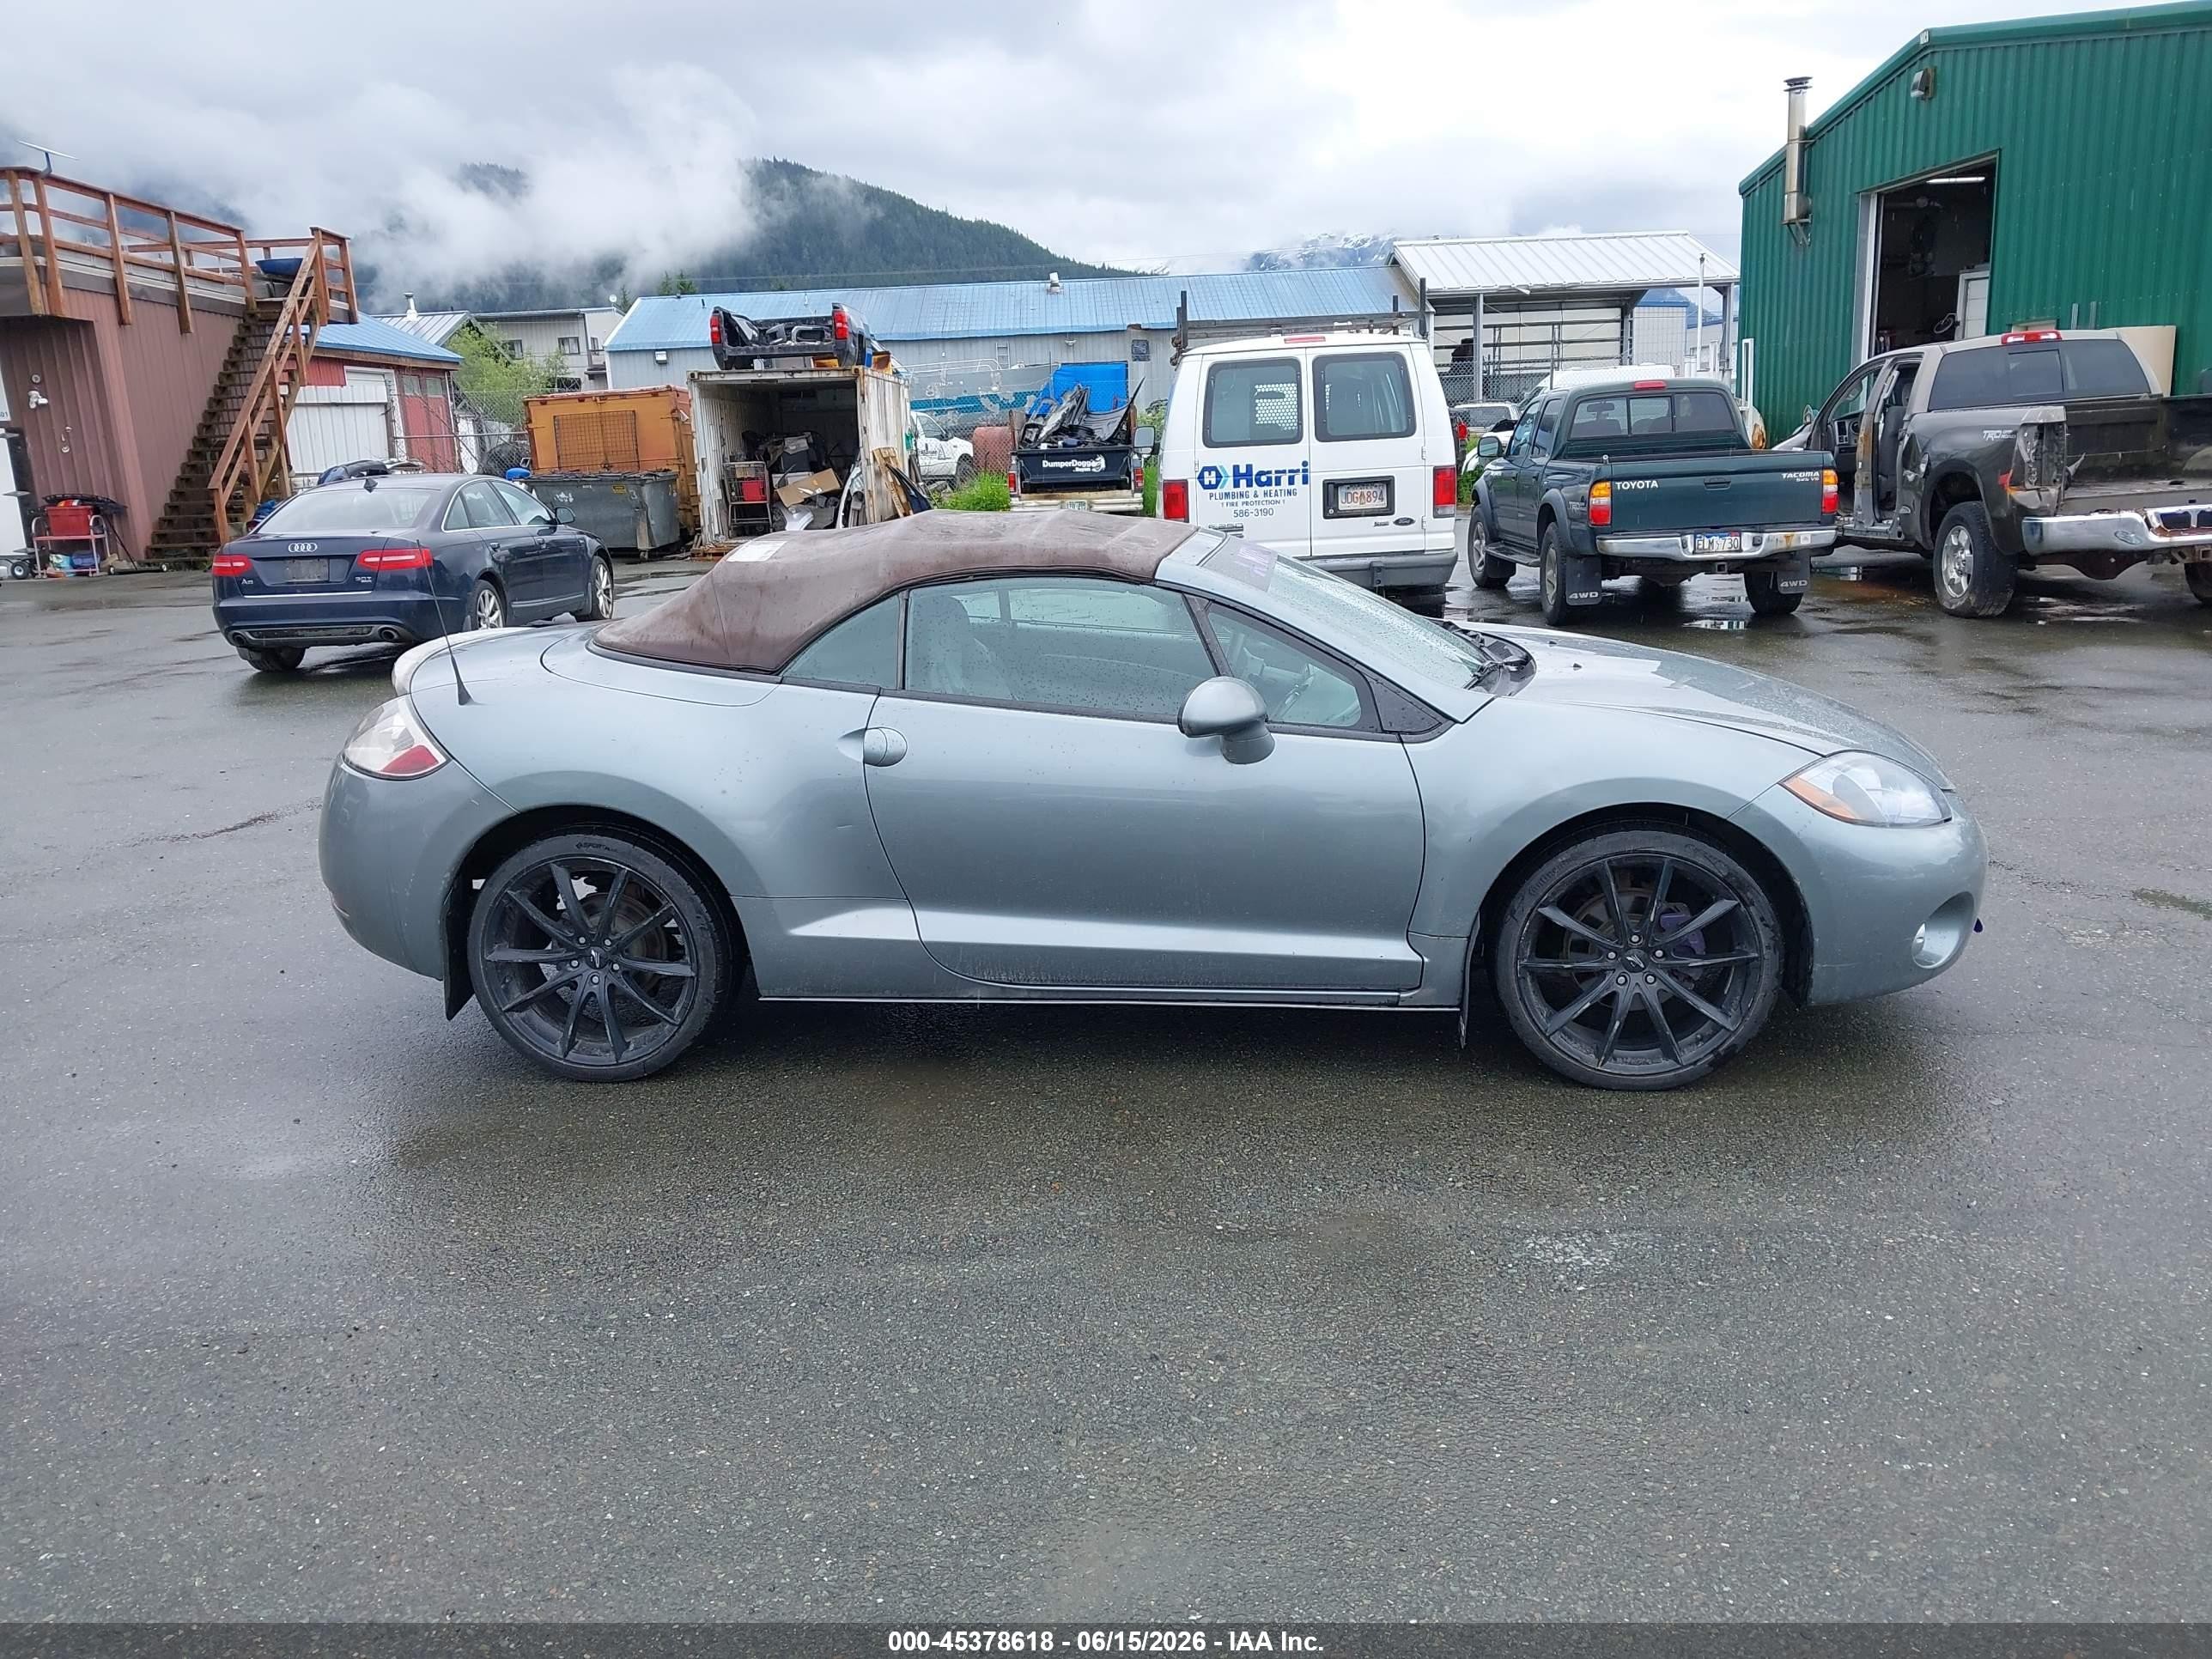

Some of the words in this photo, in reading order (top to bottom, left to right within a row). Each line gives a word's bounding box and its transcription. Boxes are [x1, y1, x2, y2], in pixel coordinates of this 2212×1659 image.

[1232, 460, 1309, 489] Harri
[1615, 480, 1659, 490] TOYOTA
[1209, 490, 1250, 501] PLUMBING
[1254, 489, 1259, 498] &
[1263, 489, 1297, 498] HEATING
[1366, 490, 1383, 503] 894
[1233, 507, 1274, 518] 586-3190
[1722, 538, 1739, 550] 730
